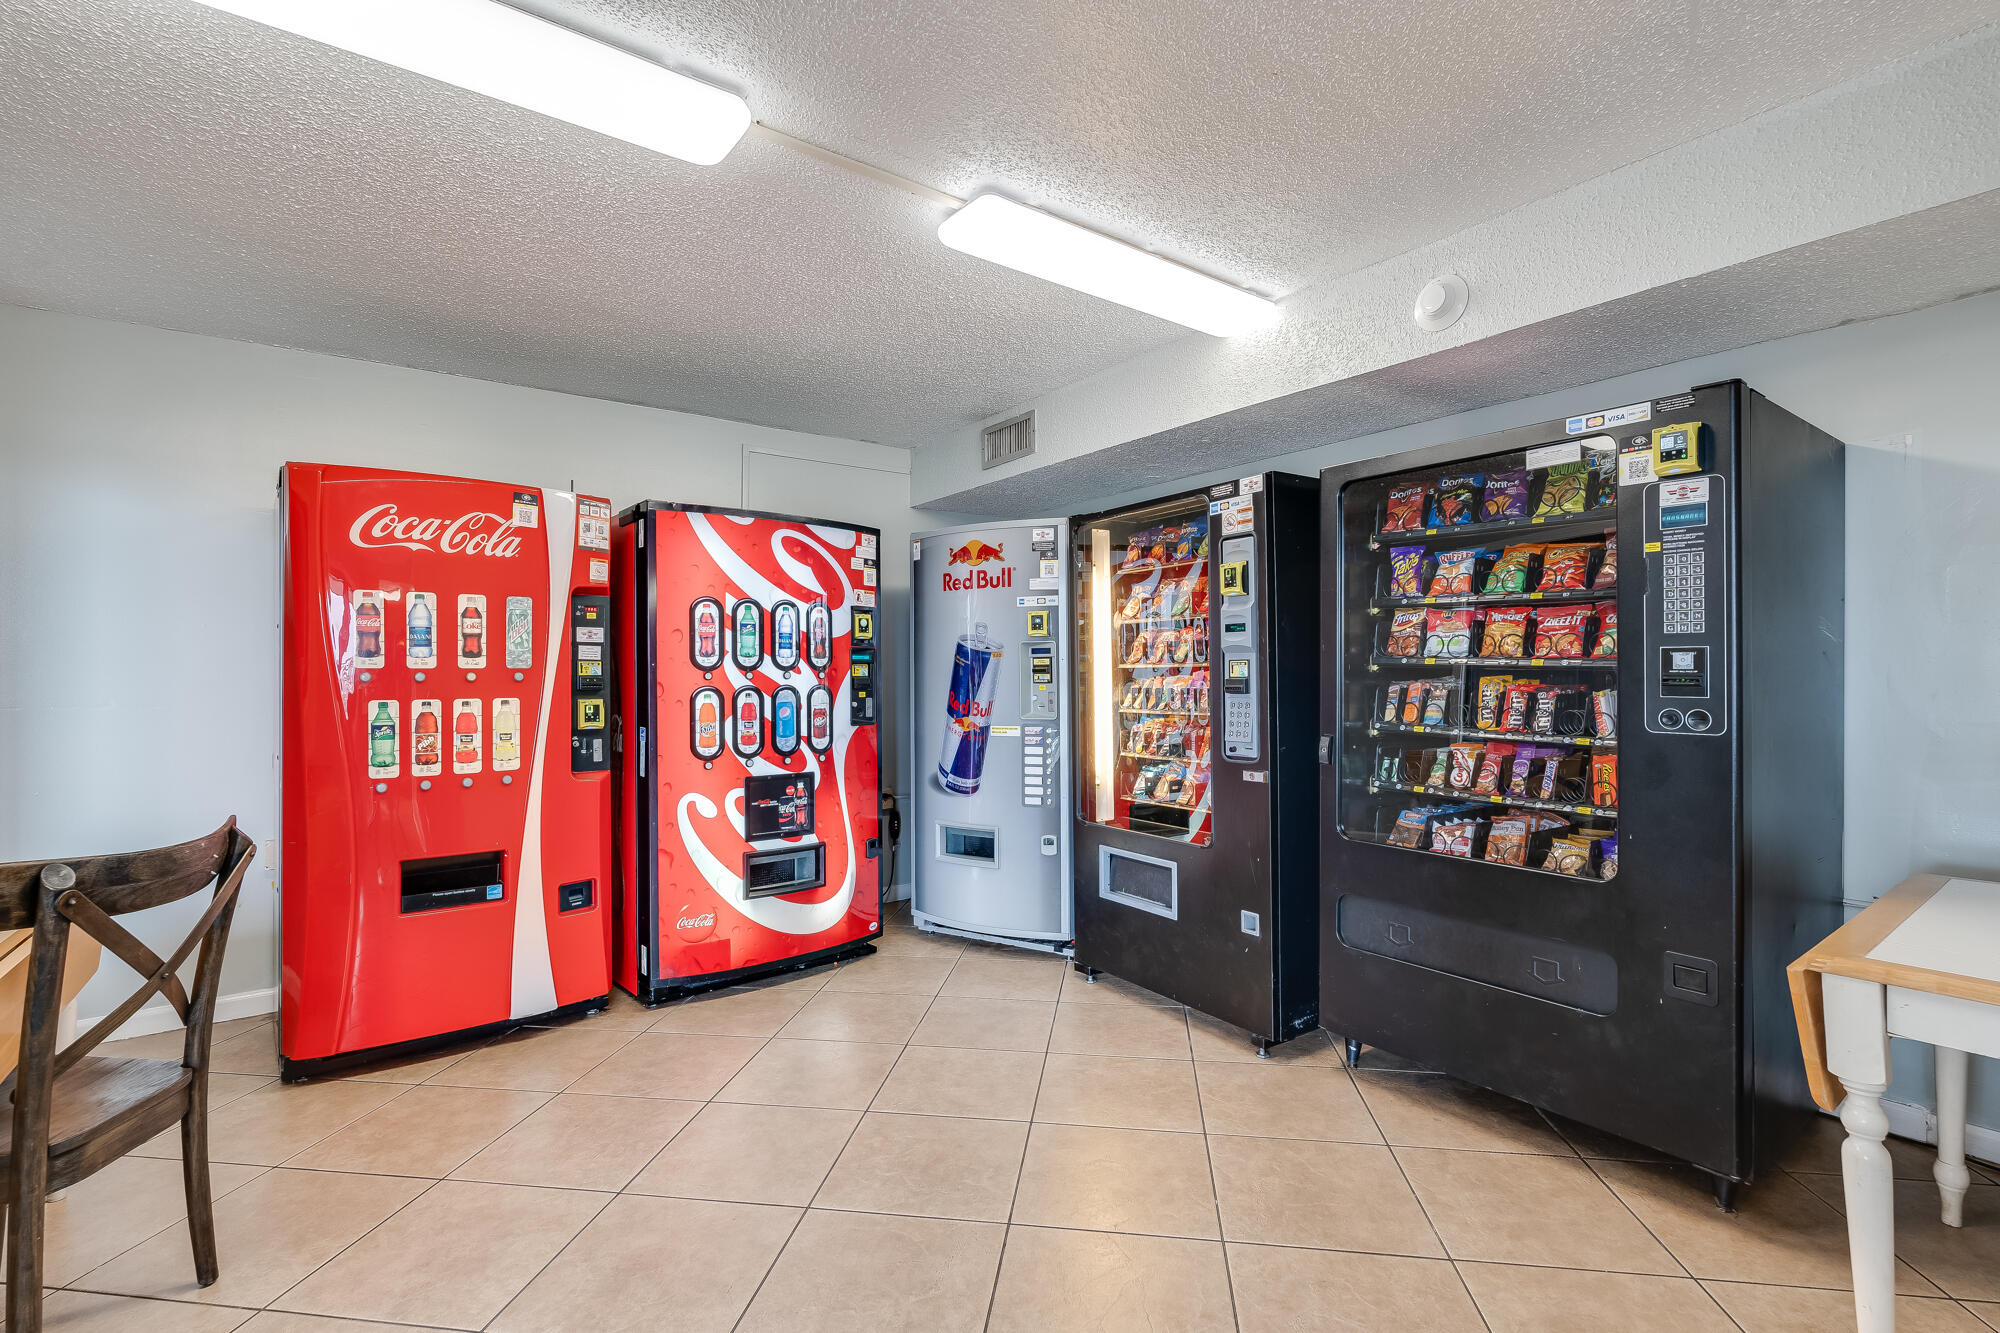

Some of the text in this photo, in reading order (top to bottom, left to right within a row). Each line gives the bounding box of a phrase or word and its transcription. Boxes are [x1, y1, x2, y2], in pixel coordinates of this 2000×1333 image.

[1607, 413, 1625, 422] VISA
[1441, 478, 1474, 487] Doritos
[1390, 487, 1423, 499] Doritos
[349, 503, 521, 558] Coca-Cola
[1394, 555, 1420, 578] Takis
[943, 567, 1012, 592] Red Bull
[356, 617, 382, 627] Coca-Cola
[462, 621, 481, 630] Coke
[1394, 613, 1421, 626] Fritos
[948, 690, 994, 717] Red Bull
[417, 735, 436, 750] Pibb
[676, 912, 716, 930] Coca-Cola
